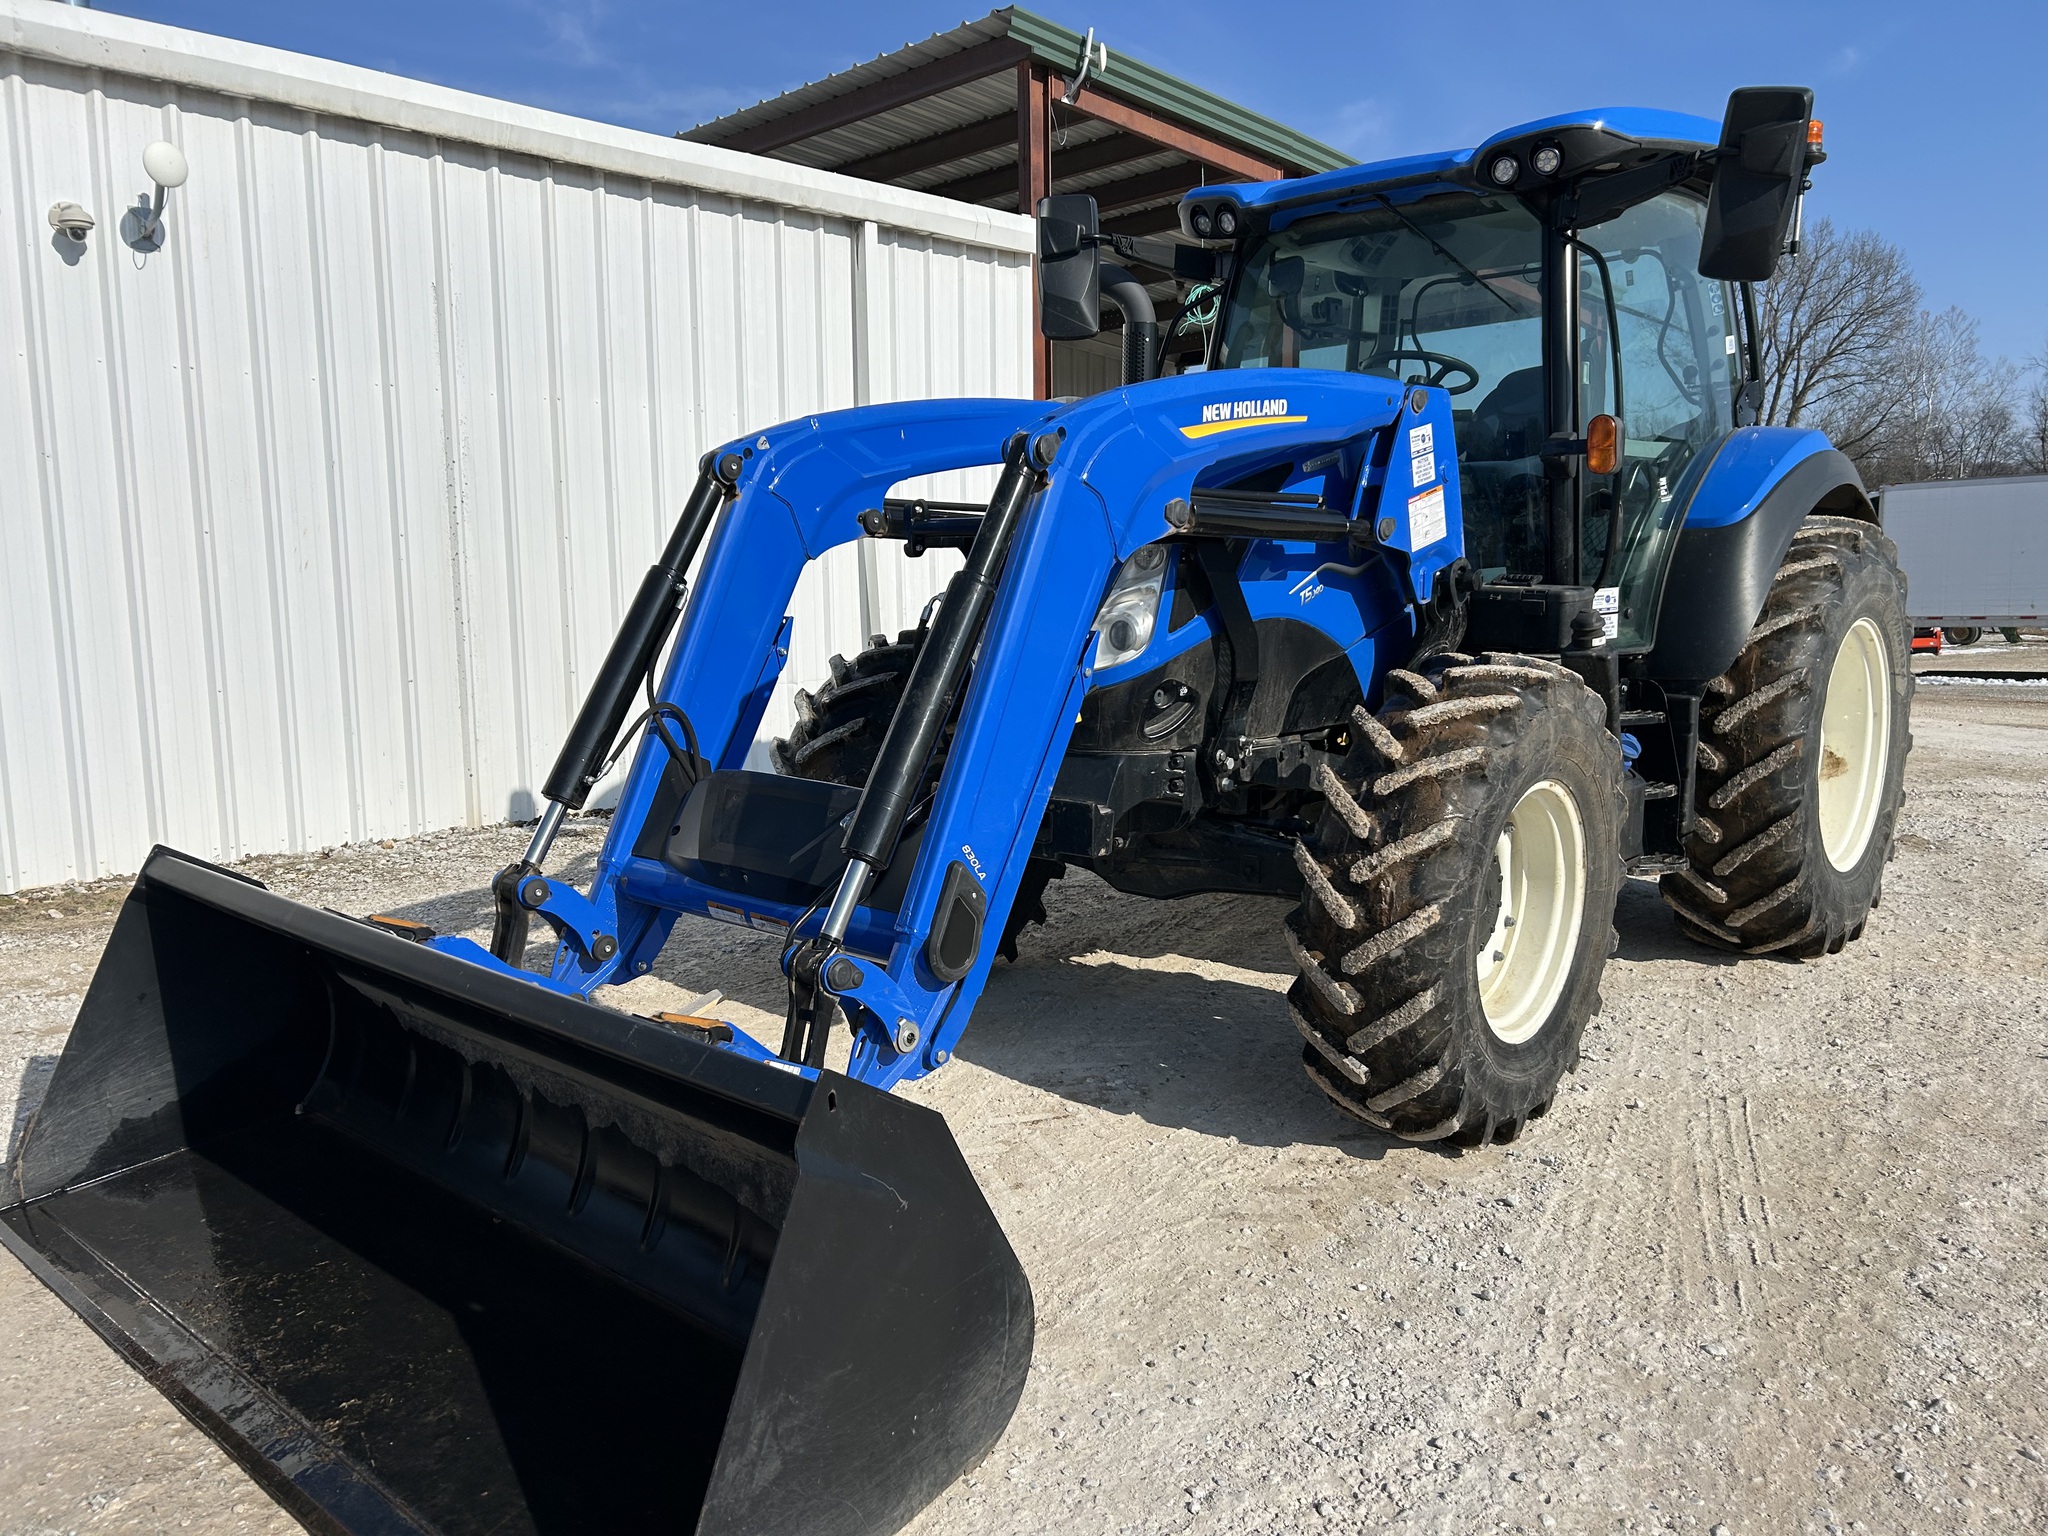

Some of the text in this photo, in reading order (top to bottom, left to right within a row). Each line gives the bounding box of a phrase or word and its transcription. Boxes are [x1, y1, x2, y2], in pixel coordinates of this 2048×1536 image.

[1202, 398, 1288, 422] NEW HOLLAND
[962, 844, 986, 880] 830LA
